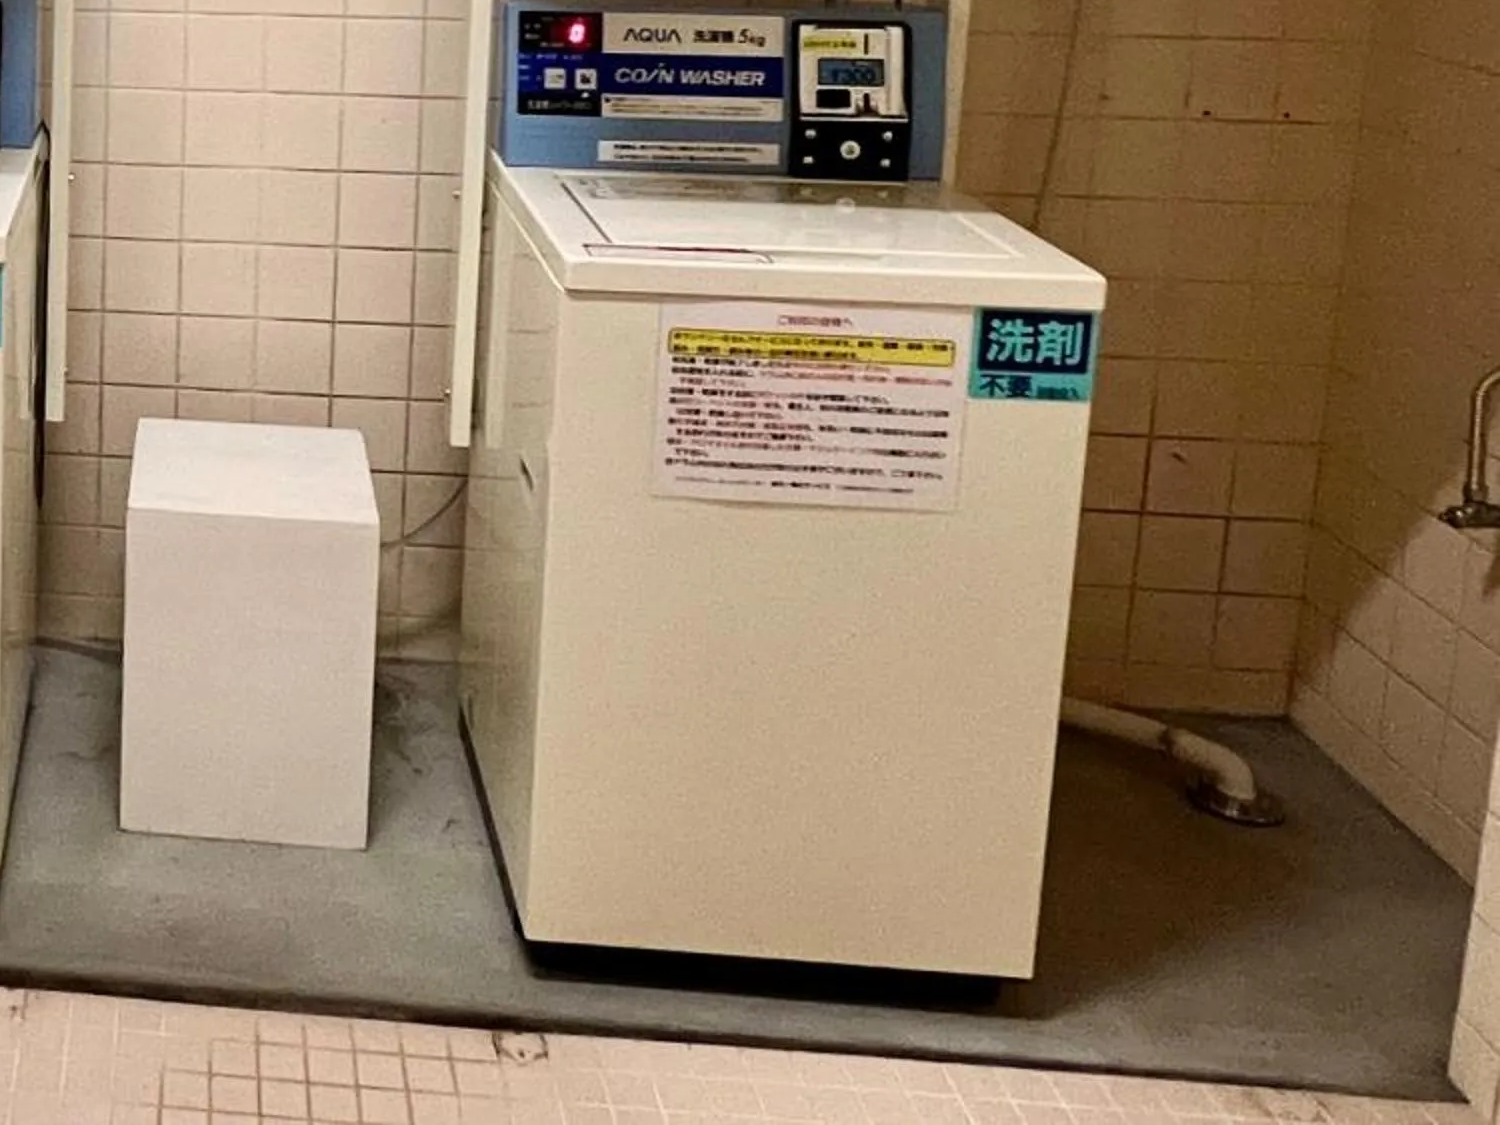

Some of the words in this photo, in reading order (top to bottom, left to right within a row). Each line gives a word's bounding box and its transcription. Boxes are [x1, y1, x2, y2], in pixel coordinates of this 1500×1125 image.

[623, 27, 682, 43] AQUA
[680, 69, 766, 86] WASHER
[986, 318, 1085, 366] 洗剤
[979, 375, 1033, 399] 不要
